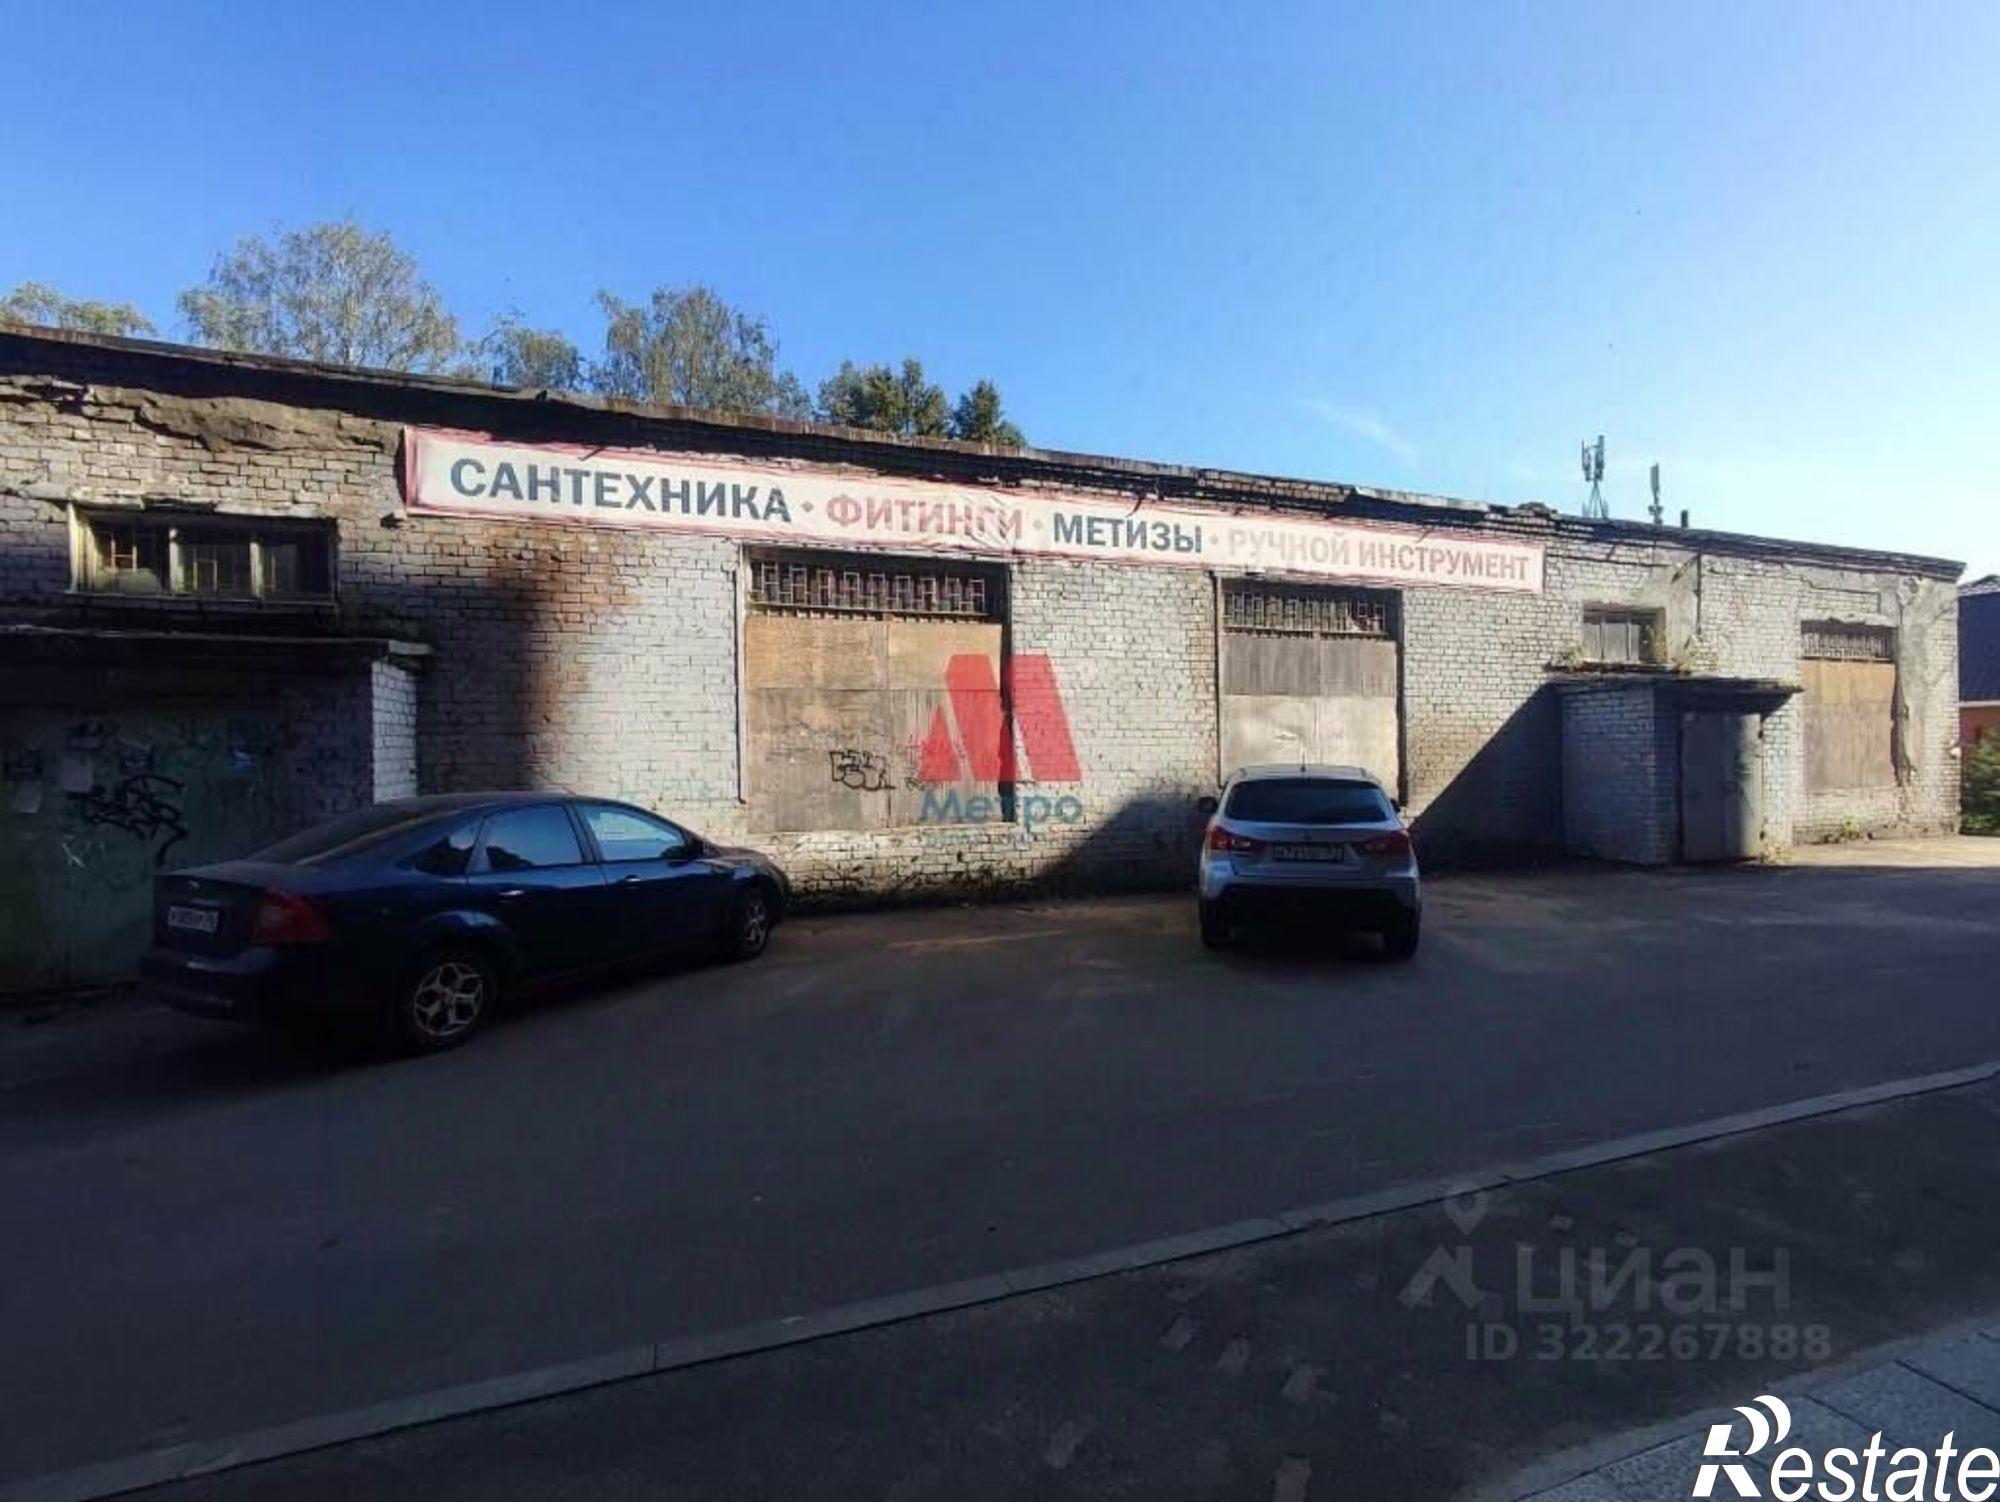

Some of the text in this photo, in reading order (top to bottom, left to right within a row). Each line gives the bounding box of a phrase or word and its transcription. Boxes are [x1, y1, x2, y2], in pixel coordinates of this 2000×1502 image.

[450, 458, 1528, 581] САНТЕХНИКА ФИТИНГИ МЕТИЗЫ РУЧНОЙ ИНСТРУМЕНТ
